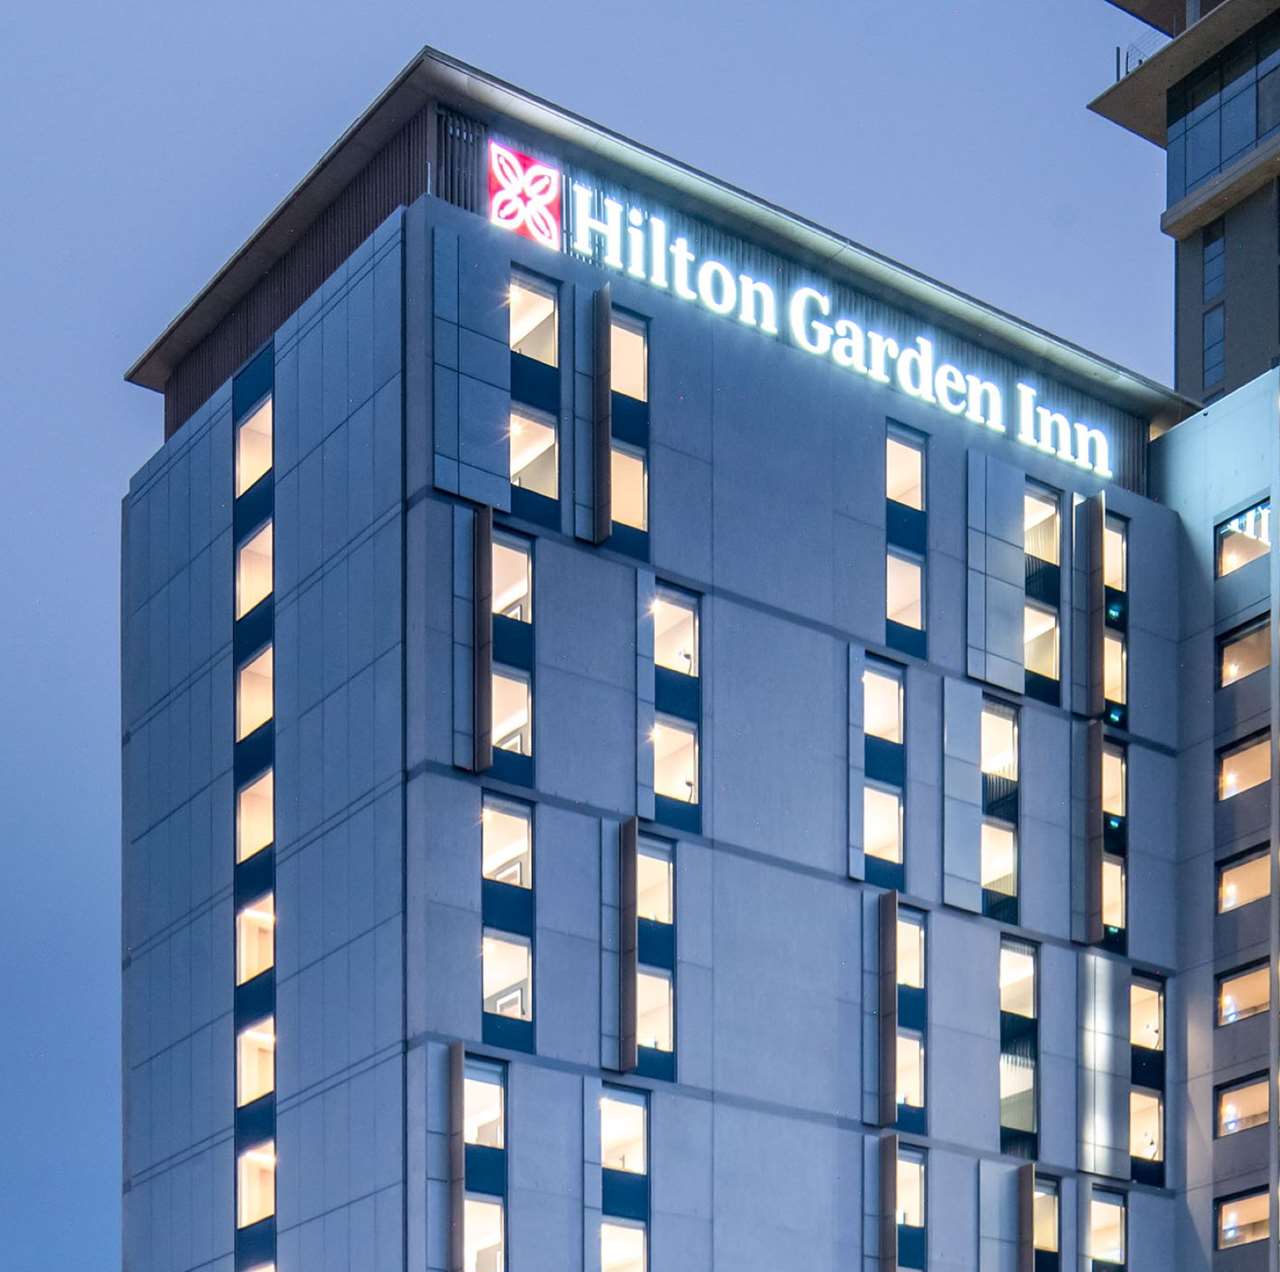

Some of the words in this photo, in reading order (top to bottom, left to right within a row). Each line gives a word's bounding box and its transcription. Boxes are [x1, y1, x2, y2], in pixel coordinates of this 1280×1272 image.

[573, 183, 779, 336] Hilton
[789, 286, 1006, 433] Garden
[1016, 381, 1113, 479] Inn
